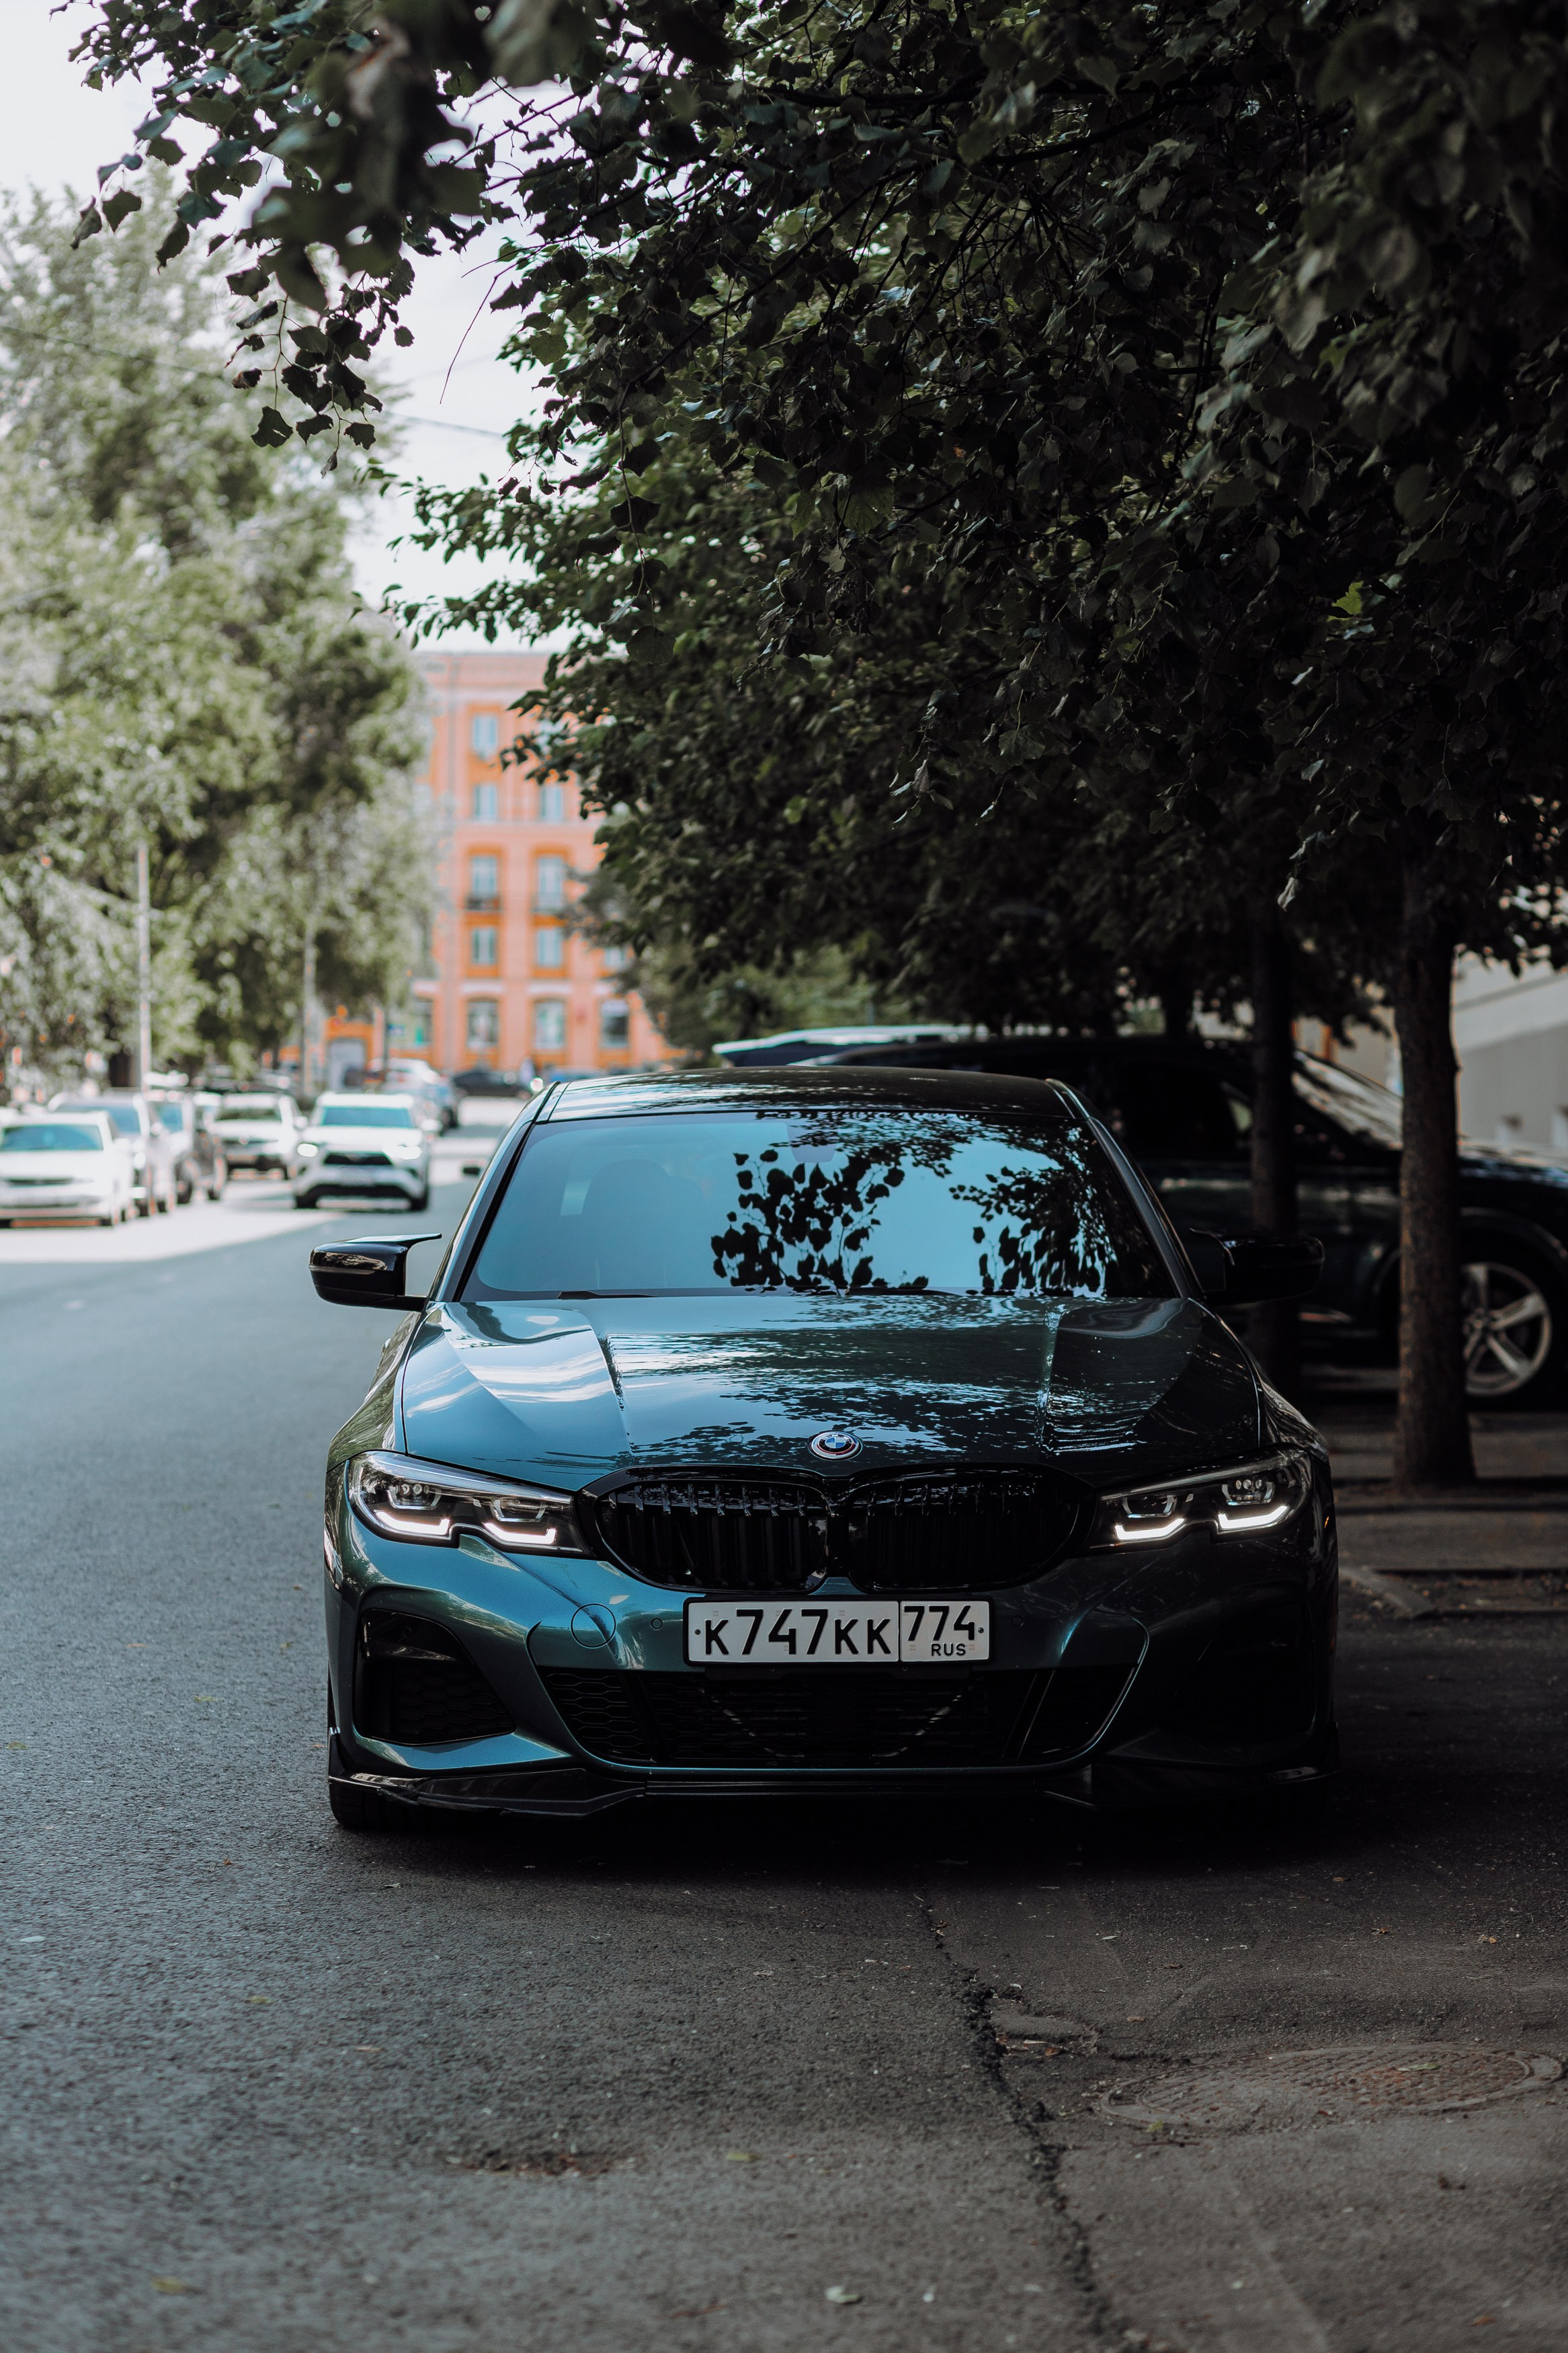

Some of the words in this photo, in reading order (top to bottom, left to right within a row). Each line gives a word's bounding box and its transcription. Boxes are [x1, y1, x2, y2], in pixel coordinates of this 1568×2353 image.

[705, 1609, 891, 1655] K747KK
[904, 1605, 975, 1641] 774
[931, 1643, 966, 1656] RUS
